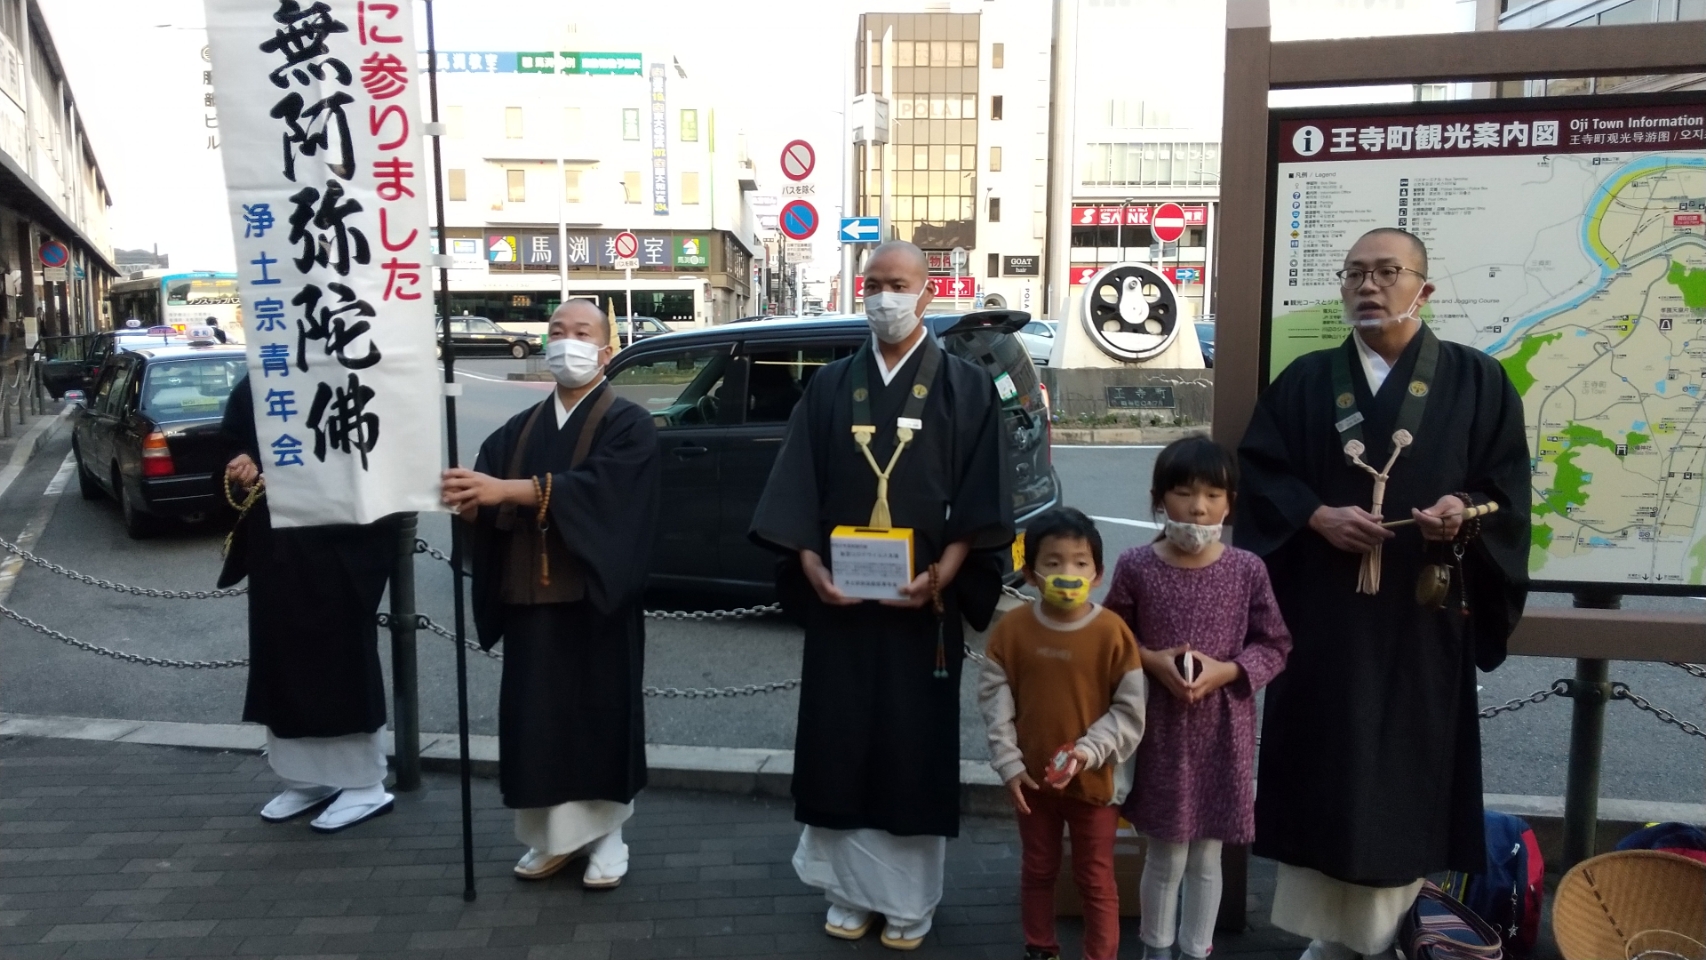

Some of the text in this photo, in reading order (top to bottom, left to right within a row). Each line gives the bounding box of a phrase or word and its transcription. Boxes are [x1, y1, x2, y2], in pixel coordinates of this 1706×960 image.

[902, 102, 953, 116] POLA
[1570, 114, 1704, 132] Oji Town Information
[1329, 120, 1560, 153] 王寺町観光案内図
[357, 1, 422, 301] に参りました
[782, 185, 815, 195] バスを除く
[242, 203, 304, 467] 浄土宗青年会
